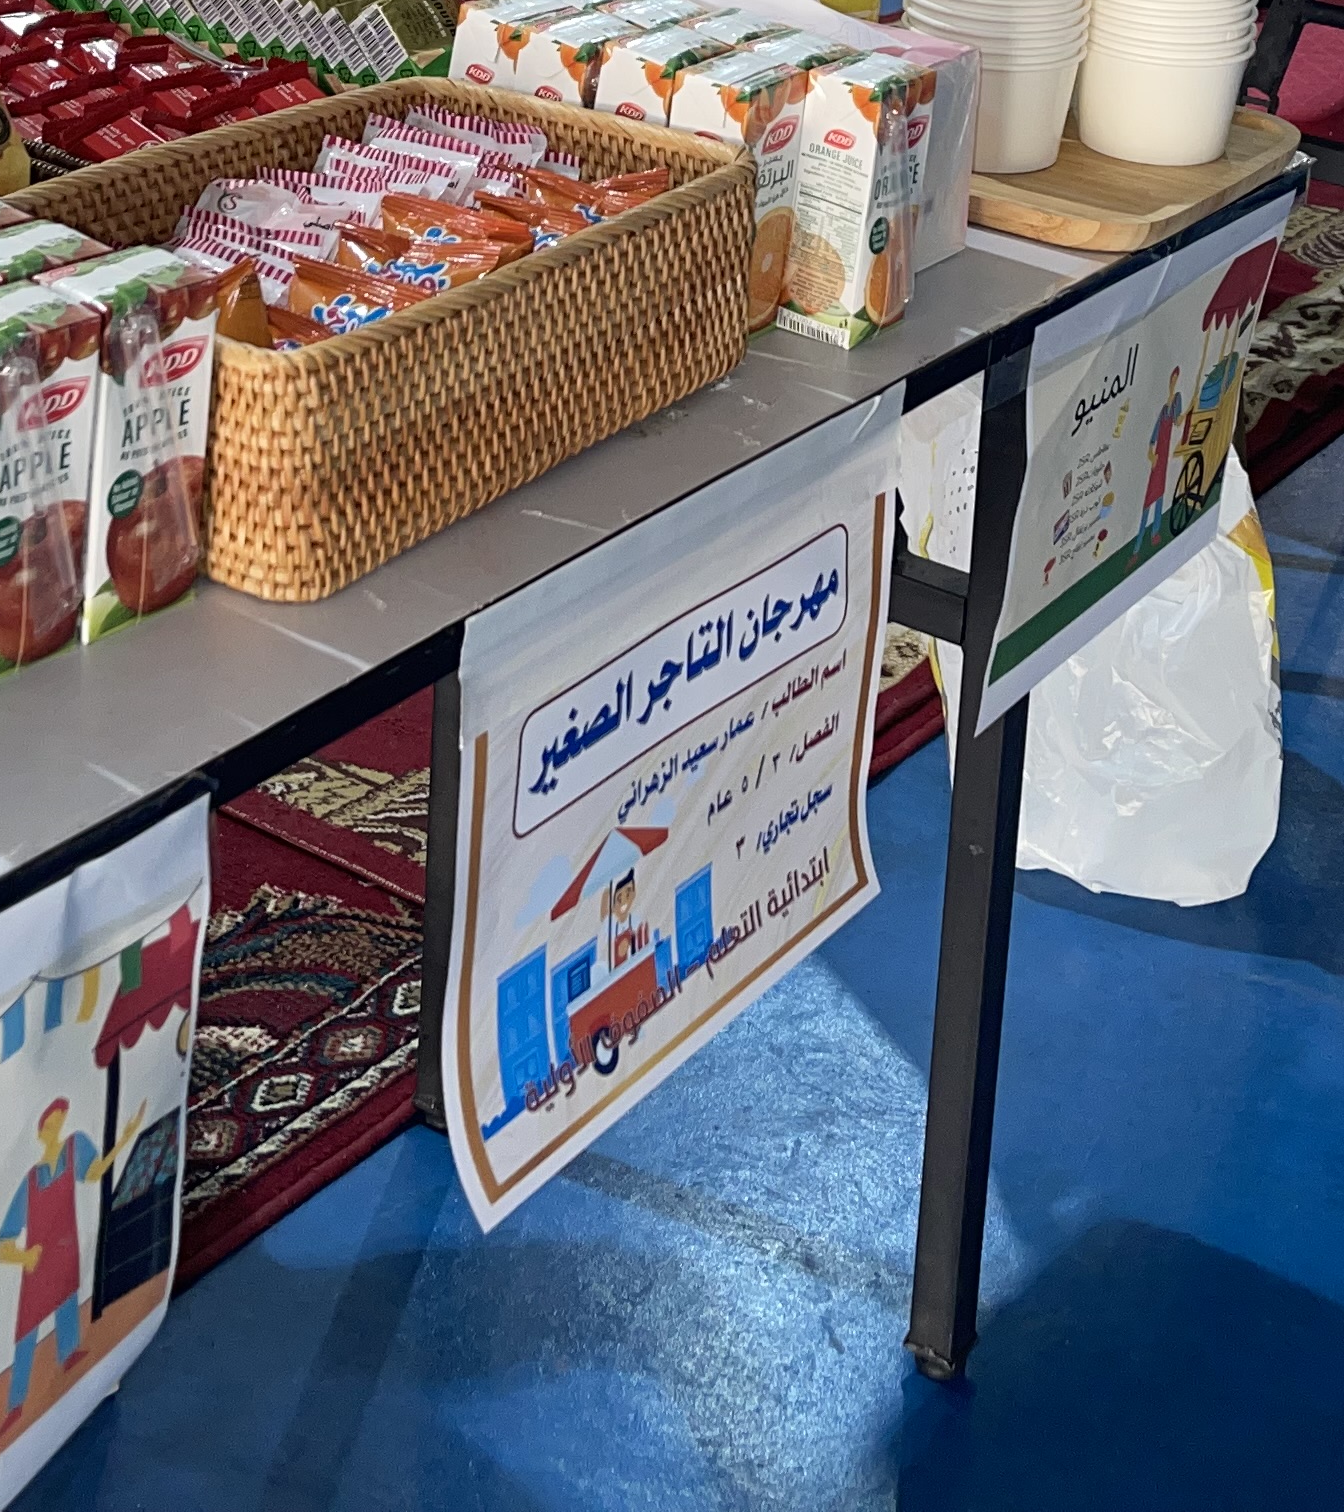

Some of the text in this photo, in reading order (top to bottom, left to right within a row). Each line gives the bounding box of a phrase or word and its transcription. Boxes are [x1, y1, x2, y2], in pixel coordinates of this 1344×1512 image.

[468, 66, 492, 83] KDD
[619, 104, 643, 120] KDD
[766, 124, 794, 145] KDD
[809, 142, 841, 162] ORANGE
[827, 133, 853, 146] KDD
[1071, 343, 1139, 437] المنيو
[121, 398, 192, 449] APPLE
[528, 568, 839, 794] مهرجان التاجر الصغير
[821, 648, 847, 690] اسم
[772, 664, 819, 717] الطالب
[720, 711, 755, 752] عمار
[681, 736, 719, 773] سعيد
[617, 753, 679, 825] الزهراني
[741, 775, 749, 793] ٥
[800, 783, 833, 823] سجل
[707, 789, 733, 826] عام
[766, 846, 831, 918] ابتدائية
[705, 899, 764, 980] التعلم
[603, 964, 683, 1049] الصفوف
